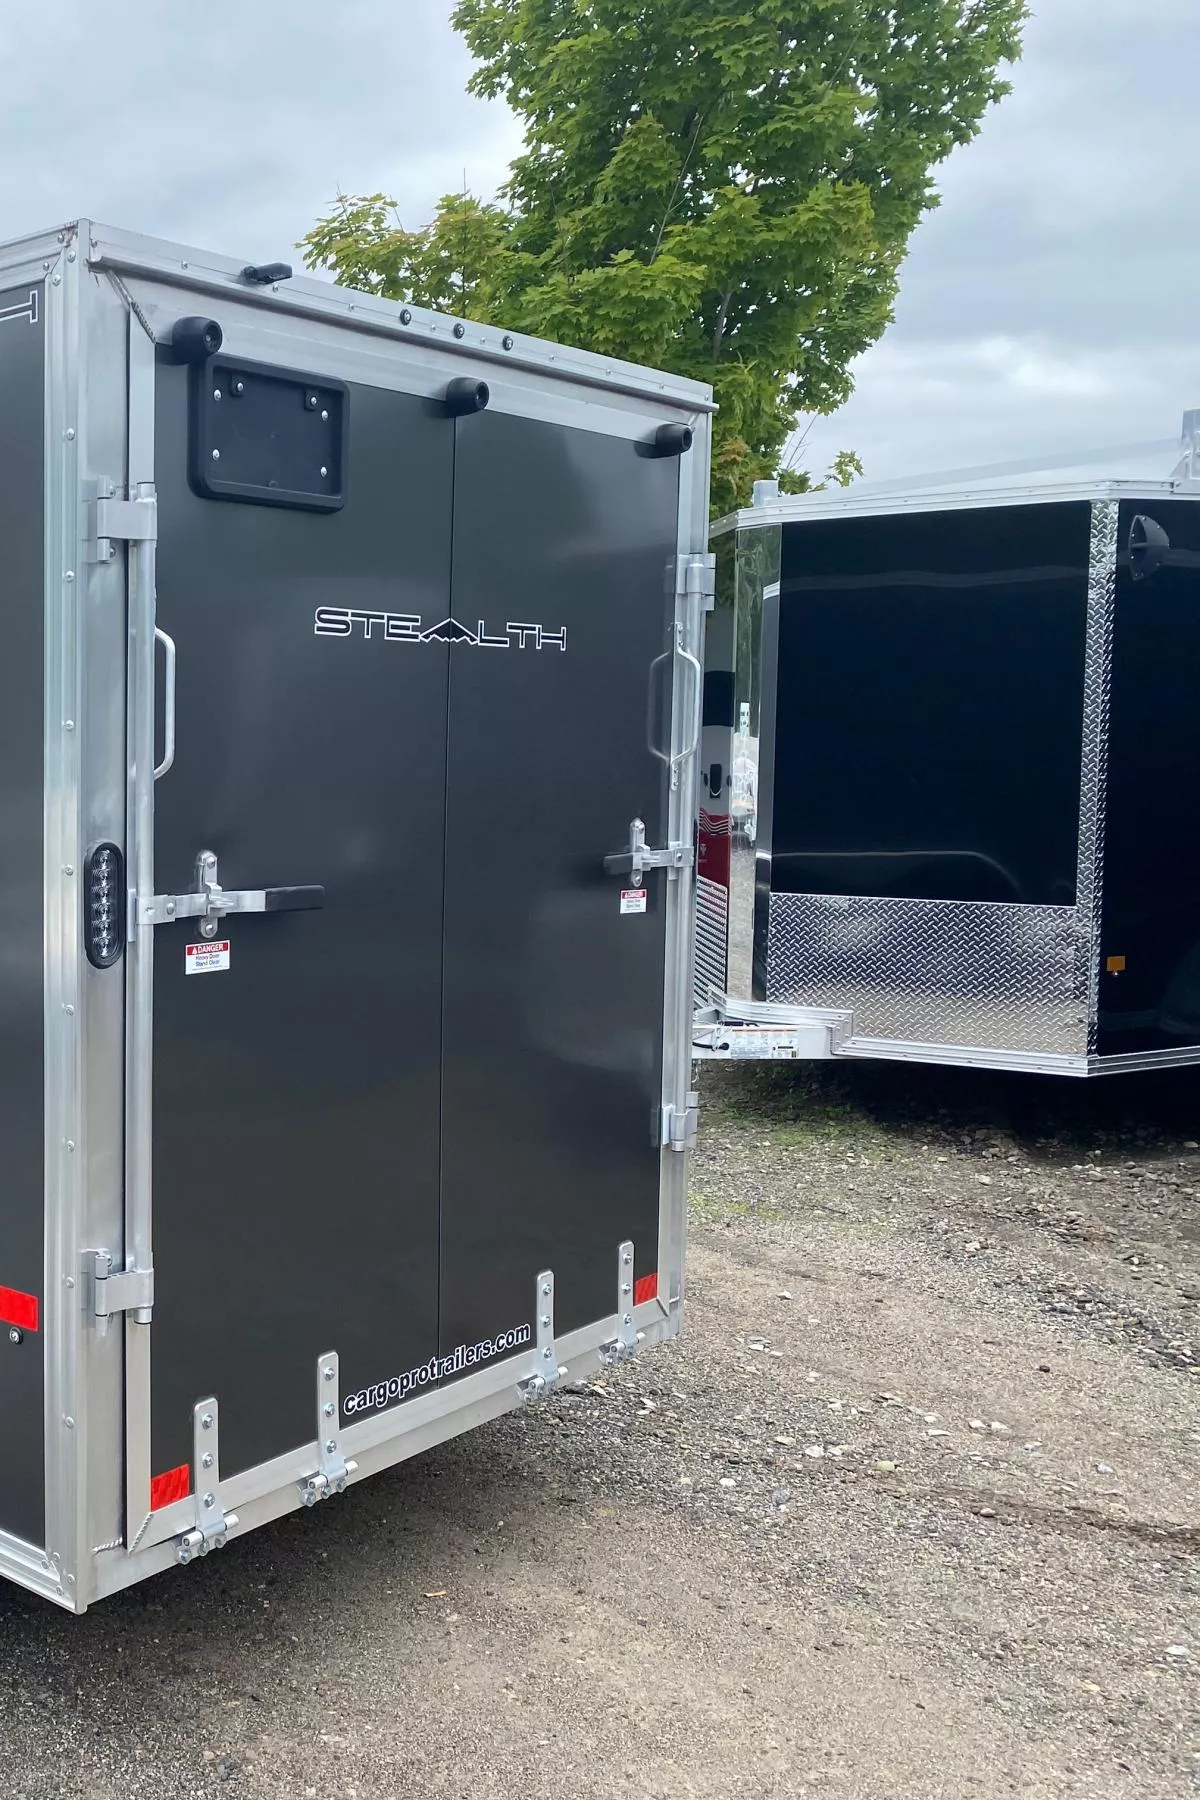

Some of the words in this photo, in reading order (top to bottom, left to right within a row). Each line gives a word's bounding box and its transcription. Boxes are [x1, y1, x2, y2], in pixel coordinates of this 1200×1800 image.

[314, 606, 567, 651] STEALTH
[197, 943, 224, 954] DANGER
[343, 1323, 531, 1415] cargoprotrailers.com
